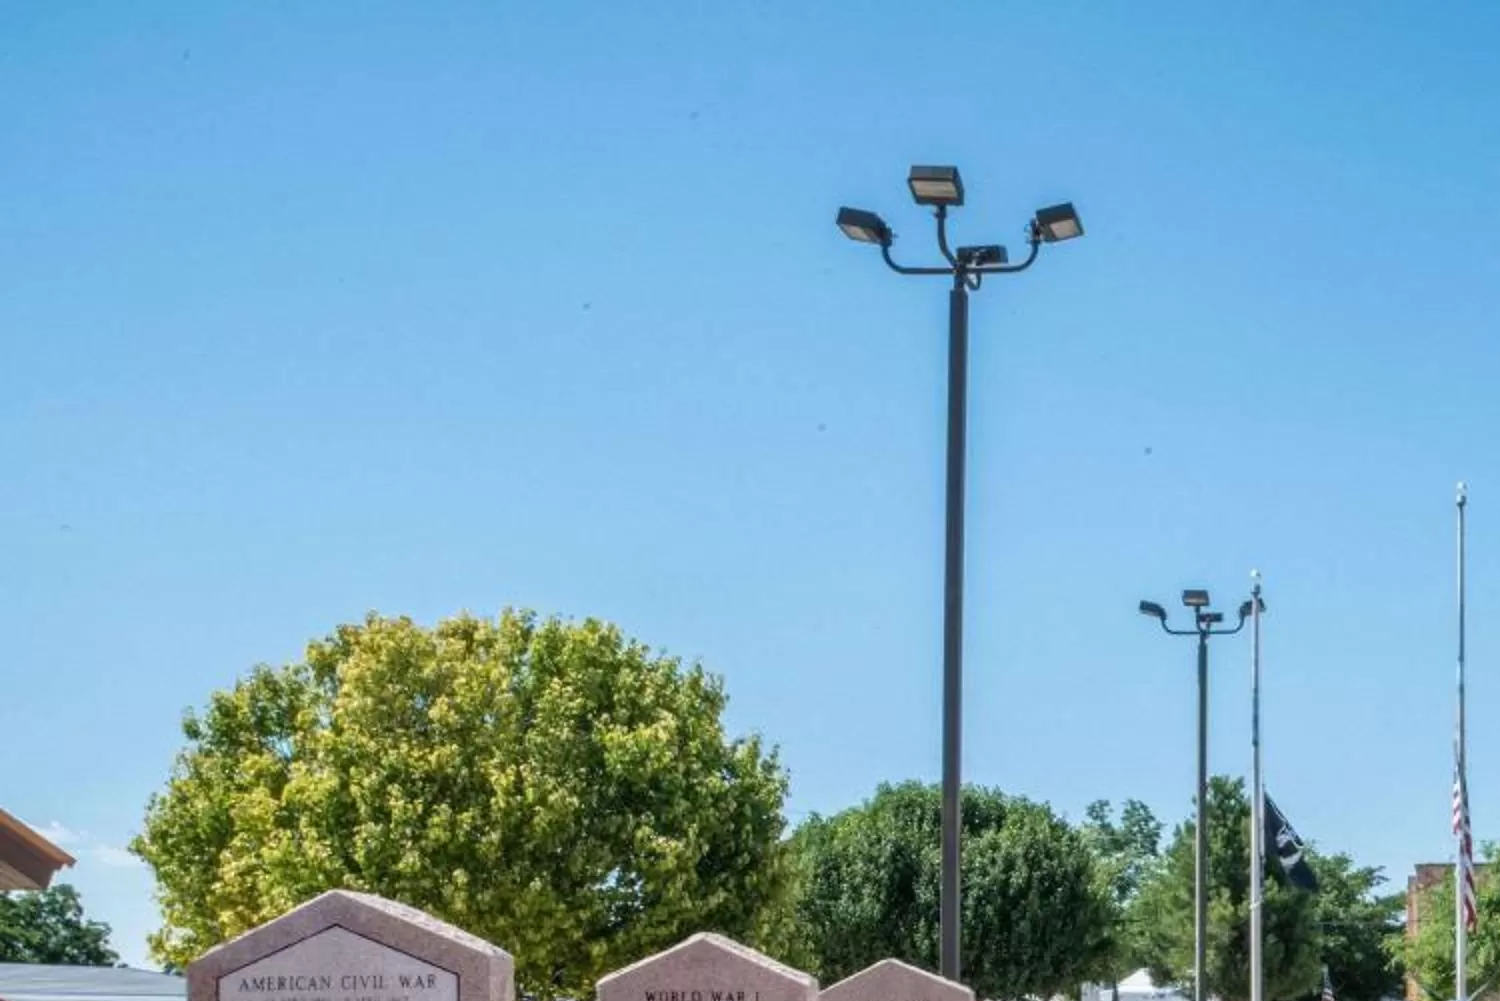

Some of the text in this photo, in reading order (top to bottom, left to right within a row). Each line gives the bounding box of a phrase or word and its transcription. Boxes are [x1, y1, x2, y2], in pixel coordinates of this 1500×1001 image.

[238, 974, 437, 991] AMERICAN CIVIL WAR
